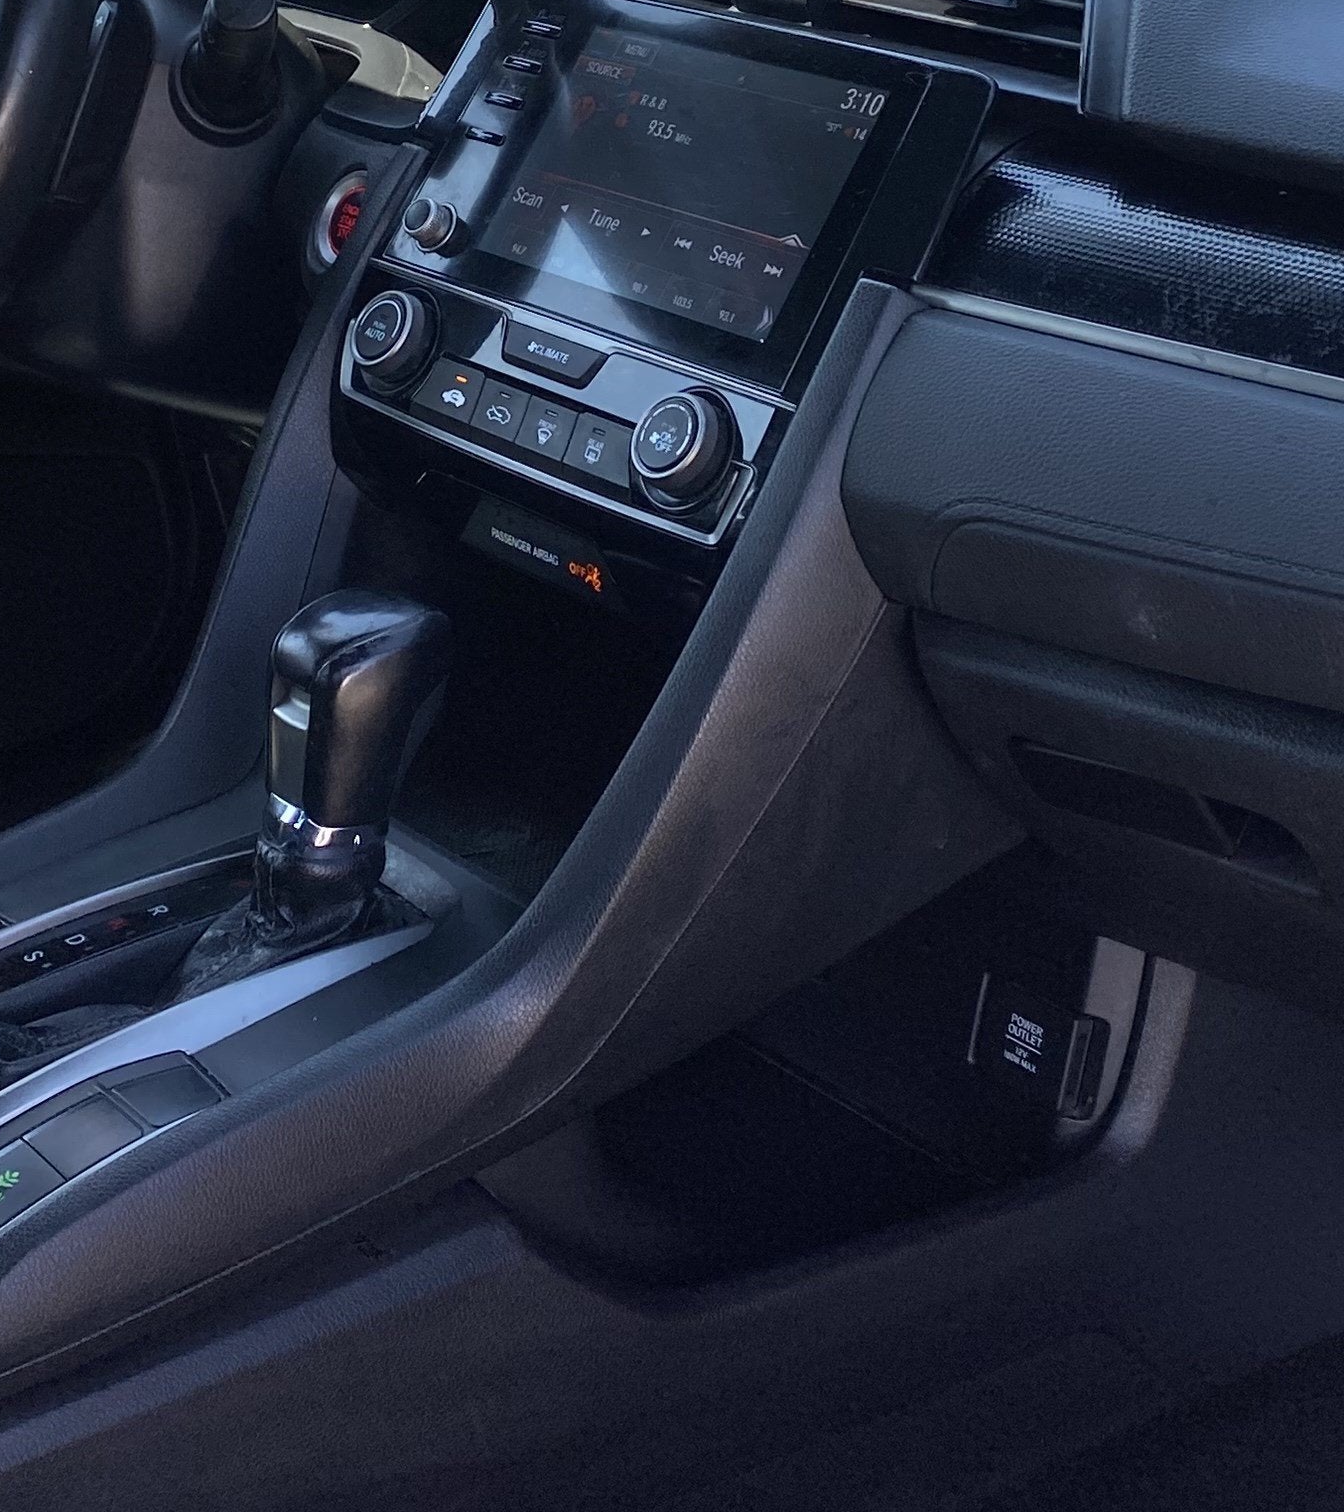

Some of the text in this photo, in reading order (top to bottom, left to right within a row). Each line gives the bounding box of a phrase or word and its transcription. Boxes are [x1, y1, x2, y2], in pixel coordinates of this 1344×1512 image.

[625, 43, 650, 58] MENU
[586, 61, 623, 79] SOURCE
[640, 94, 668, 110] R & B
[840, 88, 885, 116] 3:10
[647, 119, 676, 139] 93.5
[512, 186, 544, 208] Scan
[588, 208, 621, 232] Tune
[709, 245, 746, 270] Seek
[364, 327, 386, 341] AUTO
[535, 344, 570, 364] CLIMATE
[490, 526, 559, 567] PASSENGER AIRBAG
[568, 561, 586, 577] OFF
[147, 904, 169, 917] R
[64, 933, 86, 946] D
[23, 950, 44, 963] S
[1008, 1023, 1043, 1048] OUTLET
[1011, 1013, 1044, 1038] POWER
